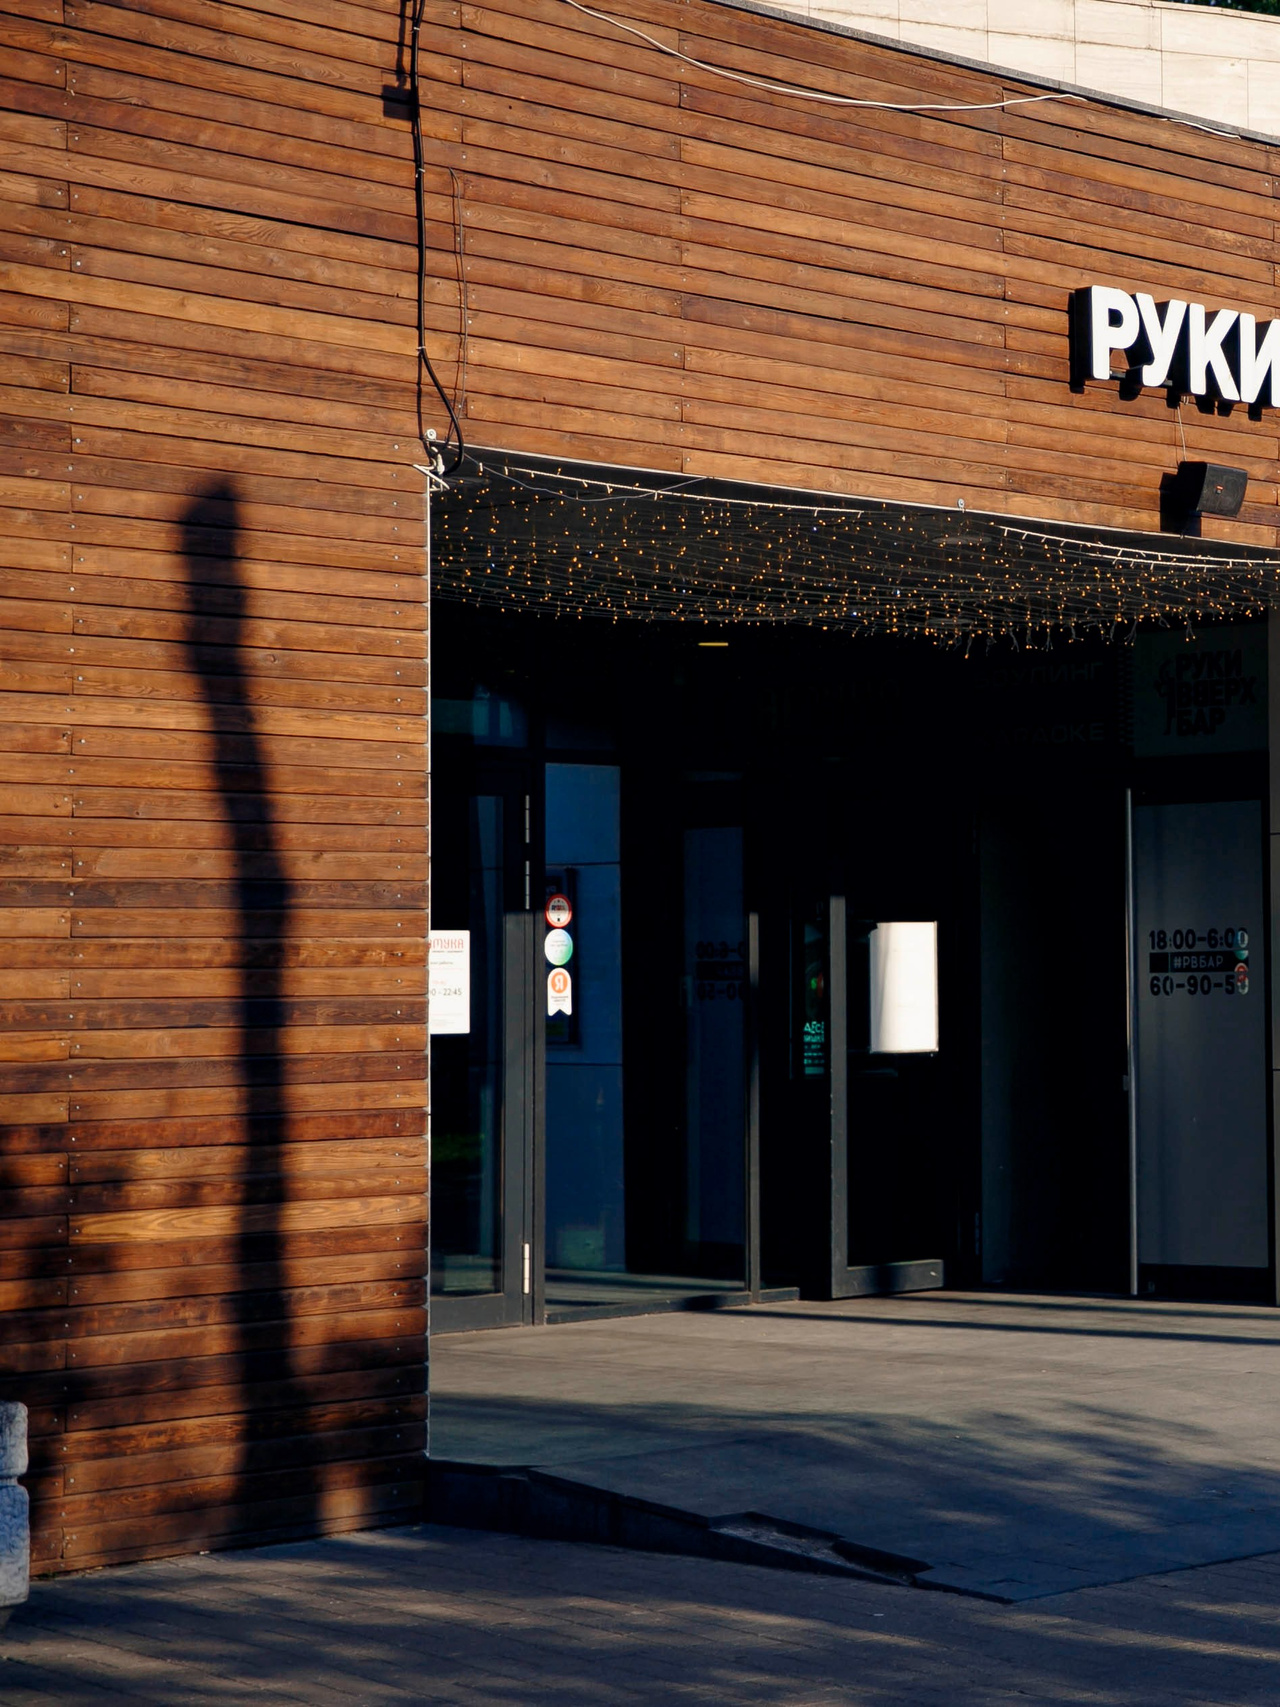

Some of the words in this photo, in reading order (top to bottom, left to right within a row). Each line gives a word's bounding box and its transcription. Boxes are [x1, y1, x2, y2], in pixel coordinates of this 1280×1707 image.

[1176, 649, 1243, 679] РУКИ
[1177, 707, 1226, 736] БАР
[1149, 927, 1249, 950] 18:00-6:00
[1173, 956, 1224, 969] #РВБАР
